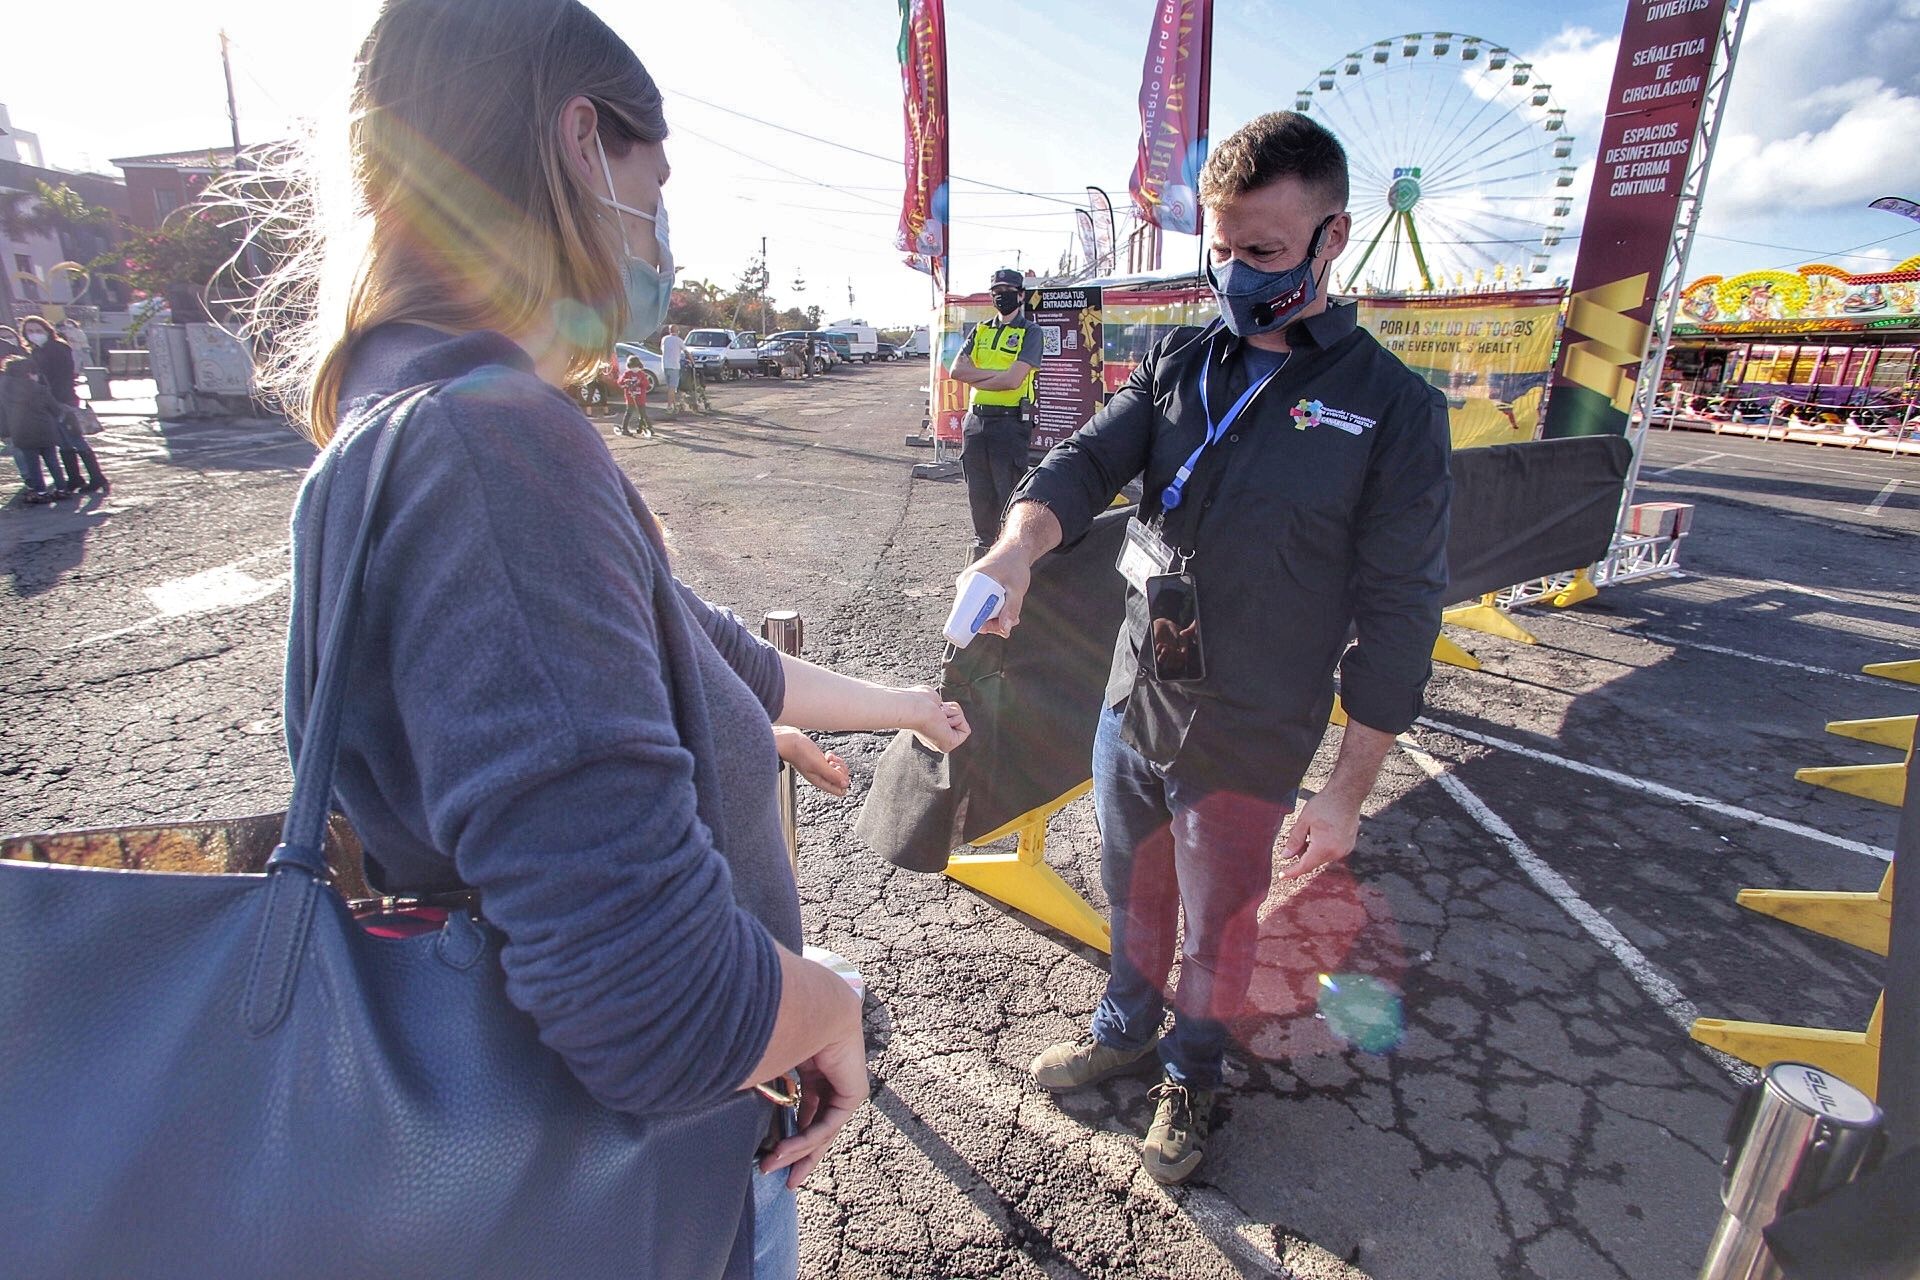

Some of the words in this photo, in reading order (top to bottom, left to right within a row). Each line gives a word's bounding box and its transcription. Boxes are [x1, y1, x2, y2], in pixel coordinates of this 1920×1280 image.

[1647, 0, 1709, 22] DIVIERTAS
[1632, 38, 1705, 67] SEÑALETICA
[1655, 63, 1674, 80] DE
[1622, 75, 1700, 104] CIRCULACIÓN
[1622, 122, 1679, 144] ESPACIOS
[1605, 139, 1689, 164] DESINFETADOS
[1613, 165, 1630, 180] DE
[1630, 159, 1671, 178] FORMA
[1610, 178, 1666, 197] CONTINUA
[1042, 292, 1072, 300] DESCARGA
[1072, 291, 1084, 299] TUS
[1043, 301, 1072, 309] ENTRADAS
[1072, 298, 1088, 308] AQUÍ
[1380, 320, 1403, 334] POR
[1405, 321, 1420, 335] LA
[1423, 321, 1463, 336] SALUD
[1464, 321, 1484, 336] DE
[1386, 339, 1405, 351] FOR
[1478, 342, 1521, 354] HEALTH
[1034, 380, 1039, 389] 3
[1034, 415, 1039, 424] 5
[1805, 1071, 1837, 1112] GUIL
